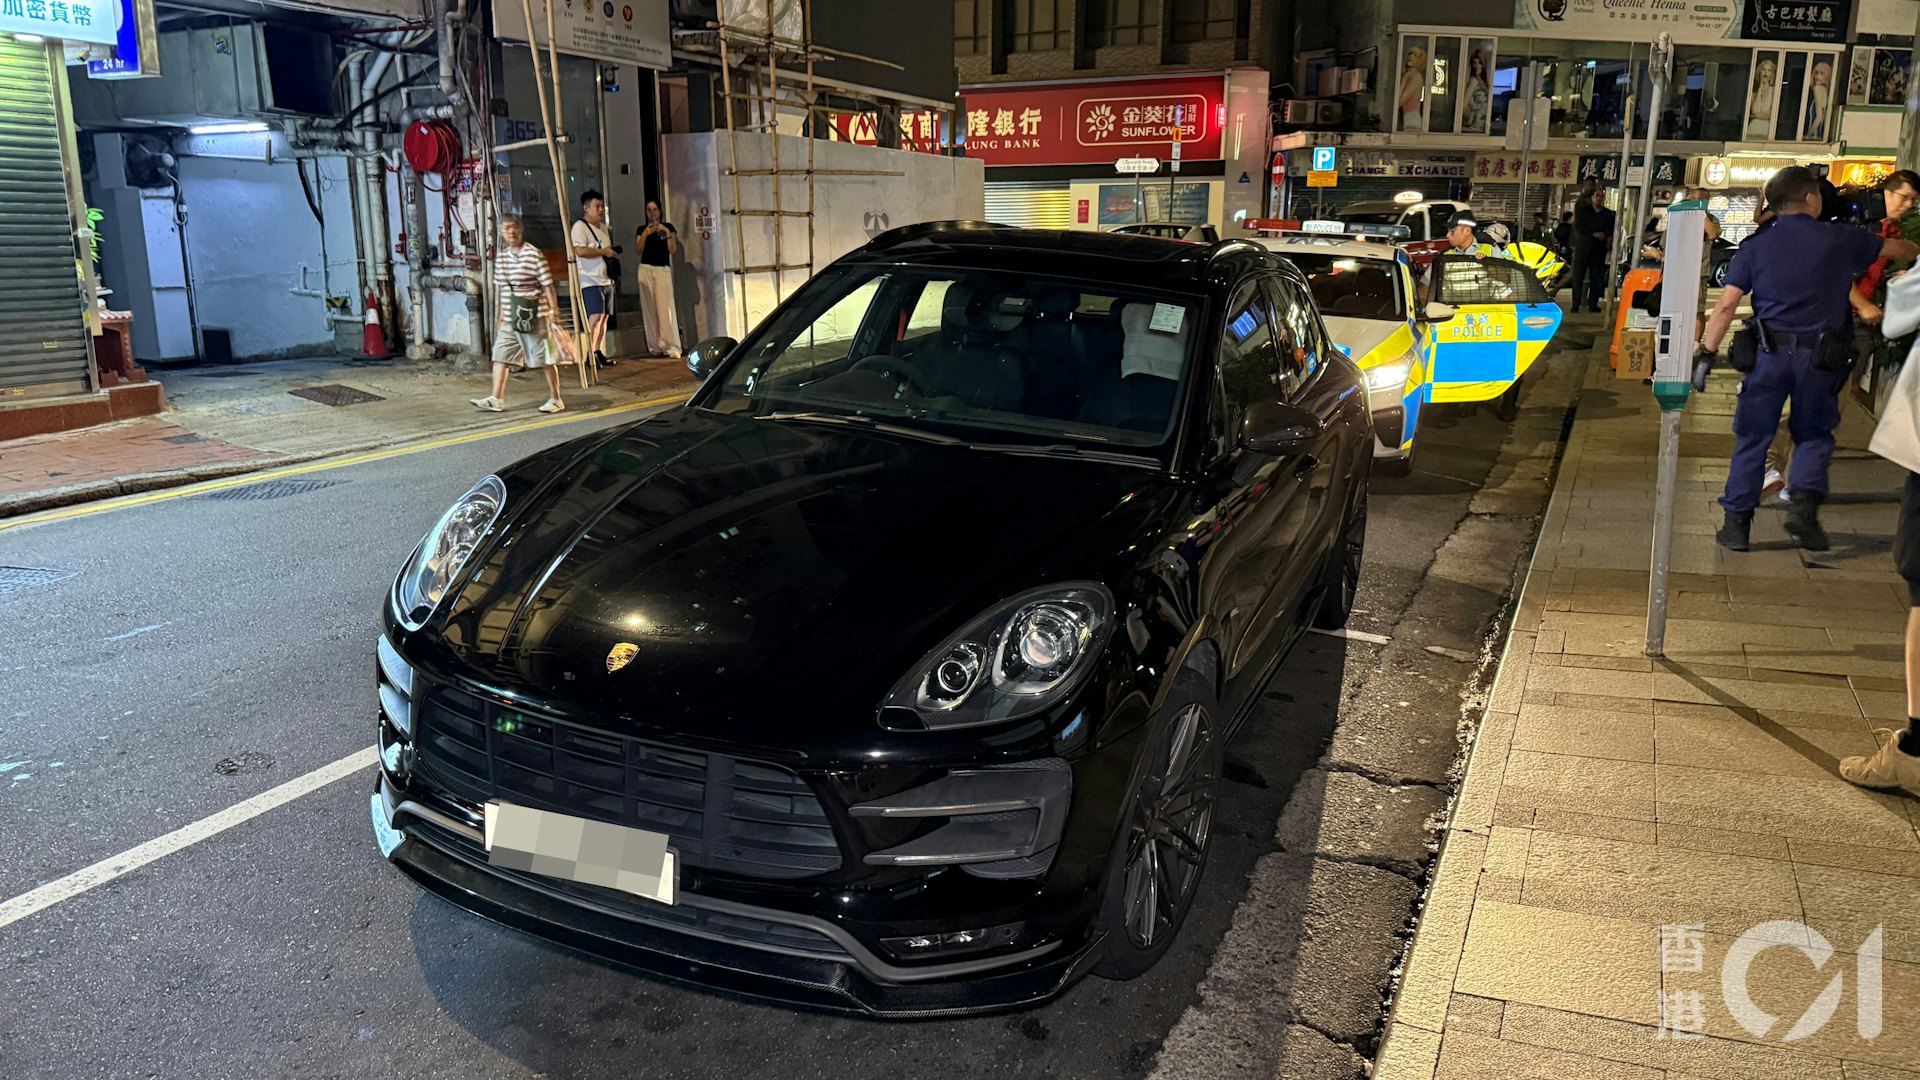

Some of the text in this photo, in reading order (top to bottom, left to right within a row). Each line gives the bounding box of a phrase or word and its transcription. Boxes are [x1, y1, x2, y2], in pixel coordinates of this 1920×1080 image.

[2, 0, 92, 26] 加密貨幣
[1602, 0, 1644, 9] Queenie
[1650, 0, 1686, 10] Henna
[1765, 3, 1833, 23] 古巴理髮廳
[102, 57, 125, 70] 24 hr
[900, 106, 1042, 140] 招商隆銀行
[964, 140, 998, 150] LUNG
[1004, 138, 1041, 149] BANK
[1316, 149, 1331, 169] P
[1345, 166, 1466, 176] CHANGE EXCHANGE
[1476, 157, 1573, 178] 富康中西醫藥
[1453, 325, 1503, 338] POLICE
